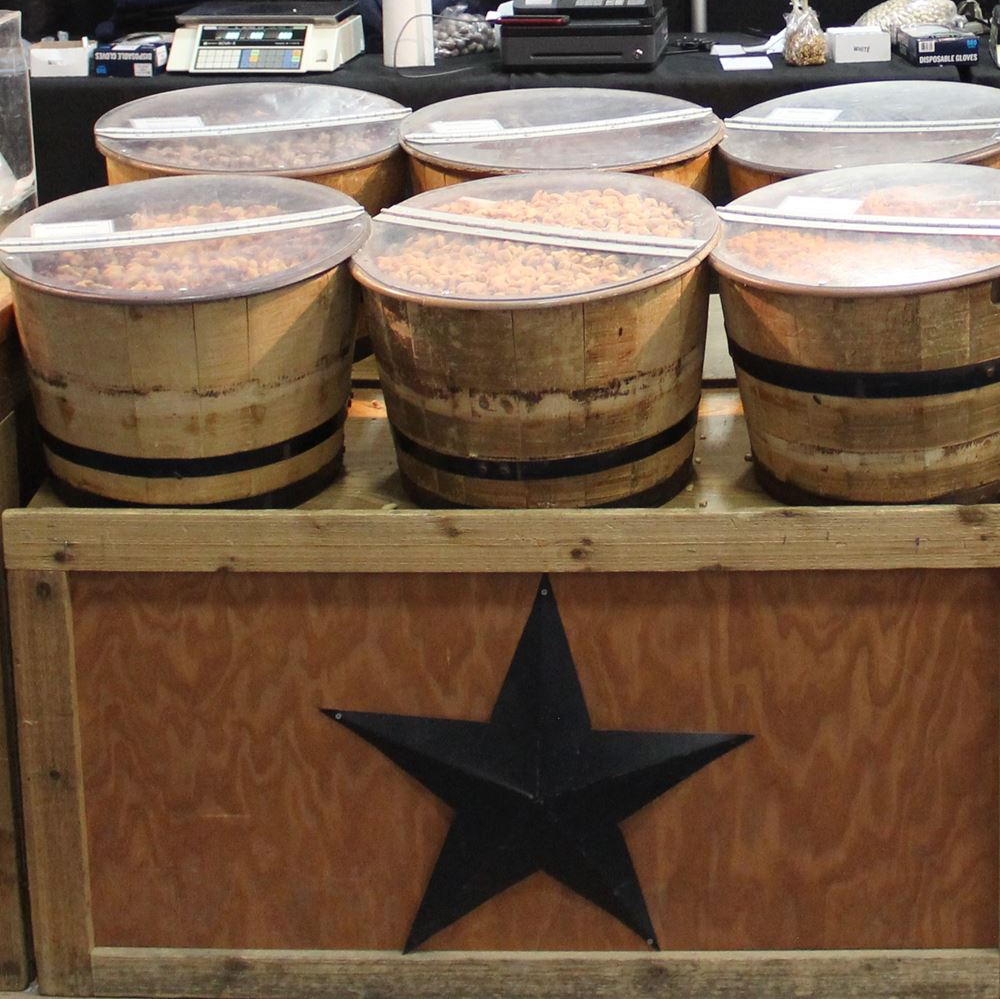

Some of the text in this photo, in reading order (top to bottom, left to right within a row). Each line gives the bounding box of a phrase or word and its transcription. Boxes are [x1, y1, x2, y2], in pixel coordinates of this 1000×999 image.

[94, 52, 153, 60] DISPOSABLE GLOVES
[919, 53, 978, 64] DISPOSABLE GLOVES
